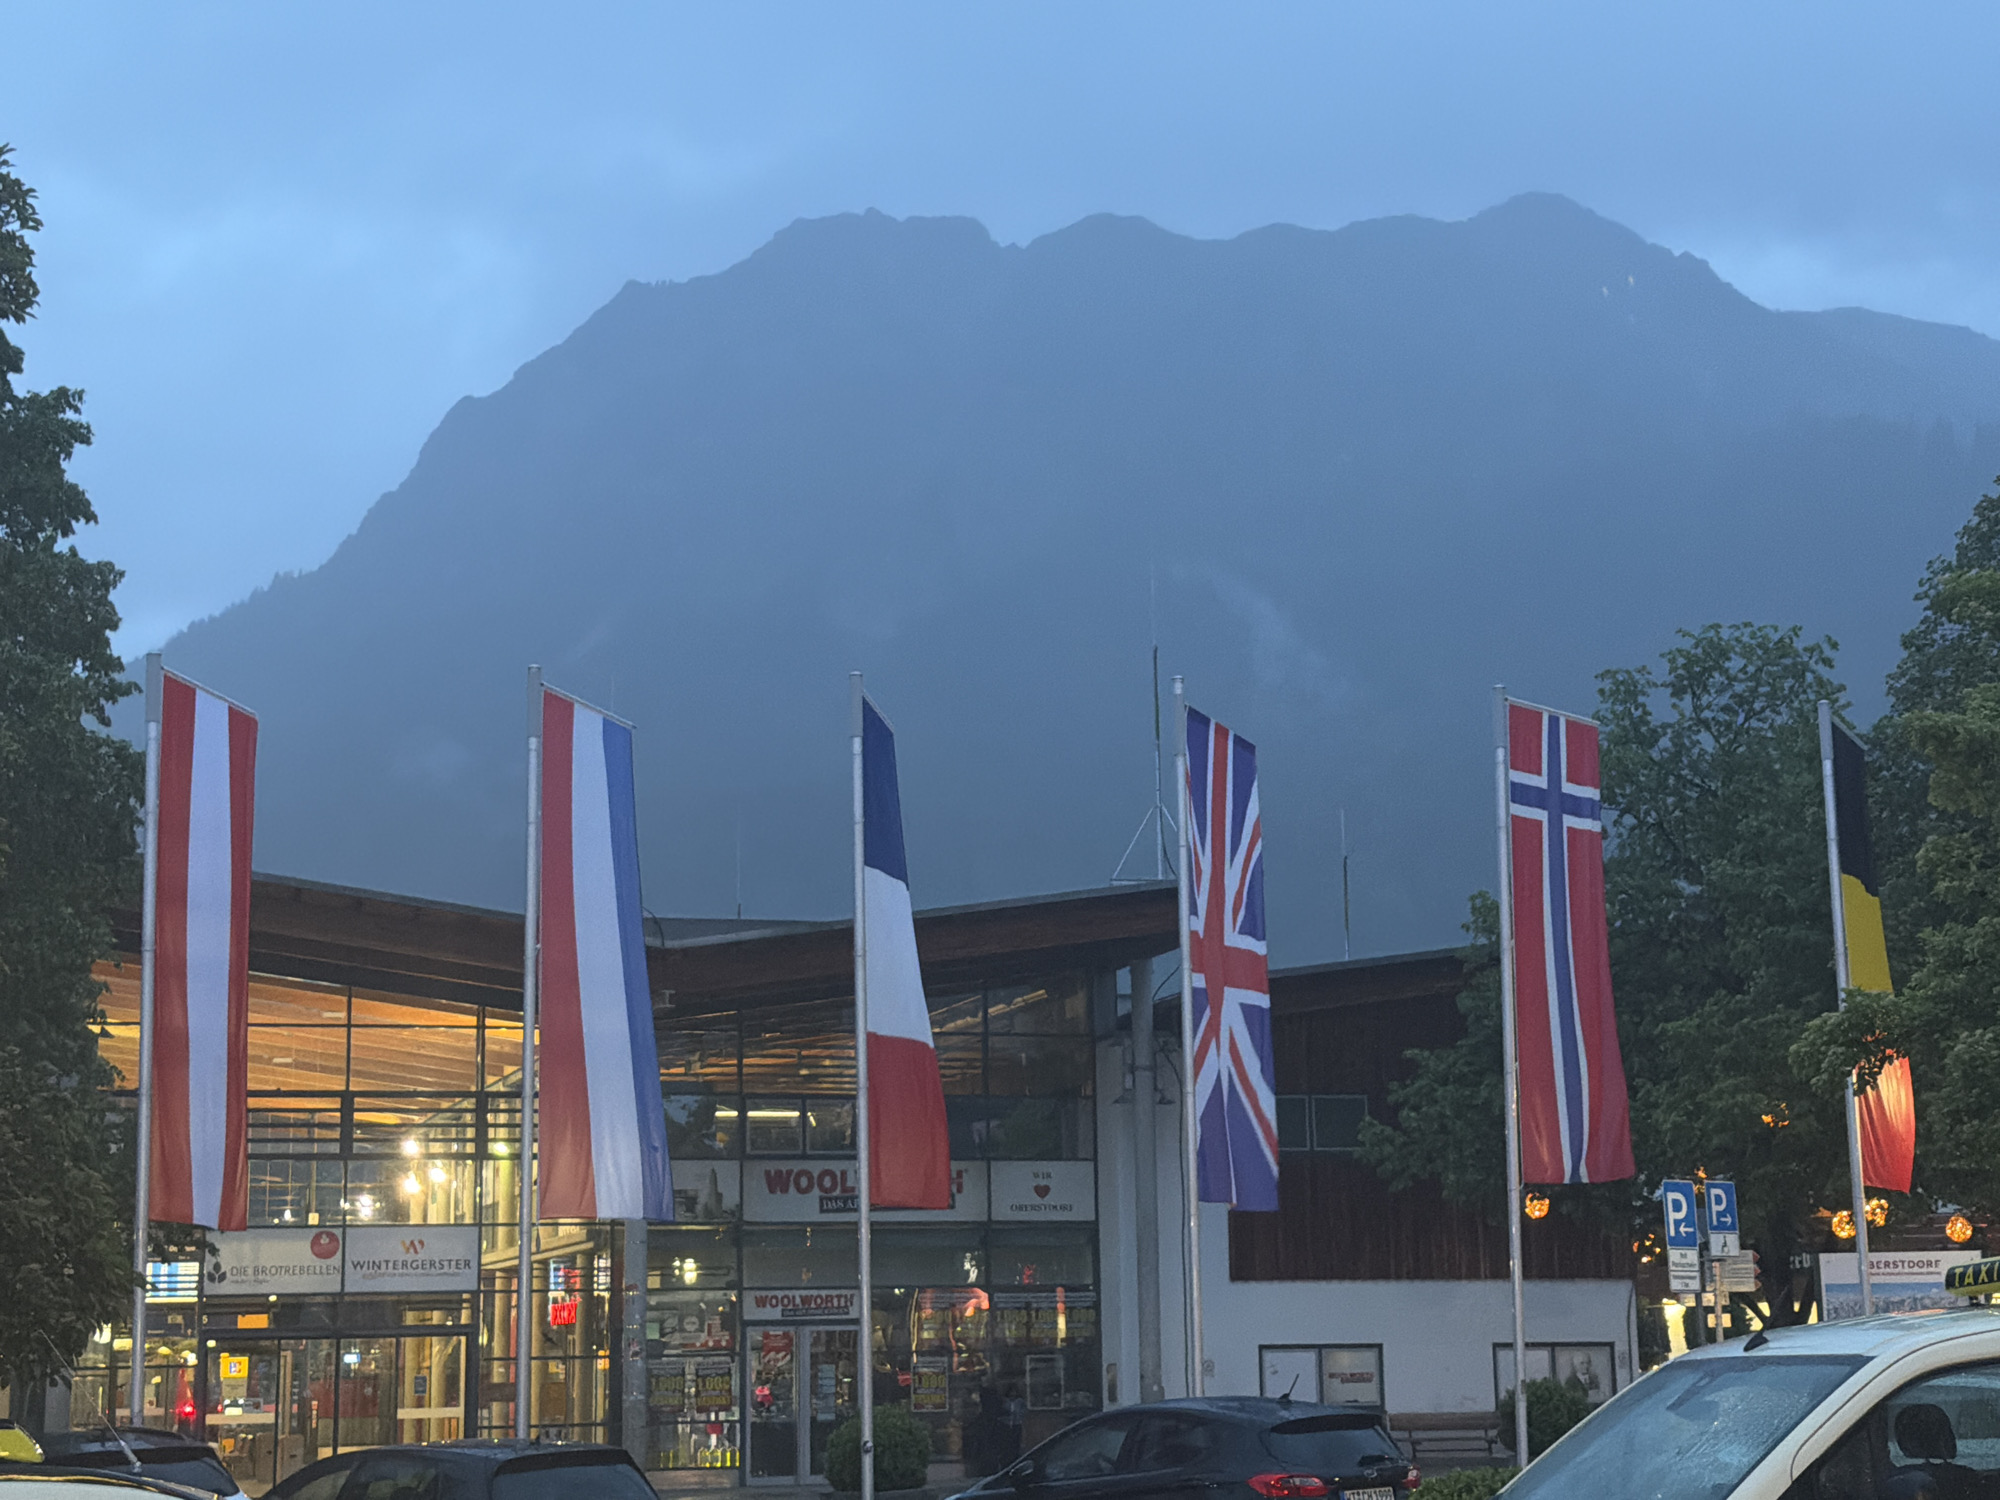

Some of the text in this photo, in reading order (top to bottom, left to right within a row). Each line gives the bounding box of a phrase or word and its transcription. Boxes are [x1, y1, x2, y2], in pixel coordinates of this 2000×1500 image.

[1667, 1192, 1687, 1237] P
[1710, 1188, 1727, 1226] P
[230, 1264, 340, 1277] DIE BROTREBELLEN
[351, 1259, 471, 1271] WINTERGERSTER
[1868, 1259, 1942, 1269] BERSTDORF
[1954, 1261, 2000, 1288] TAXI
[755, 1293, 855, 1308] WOOLWORTH
